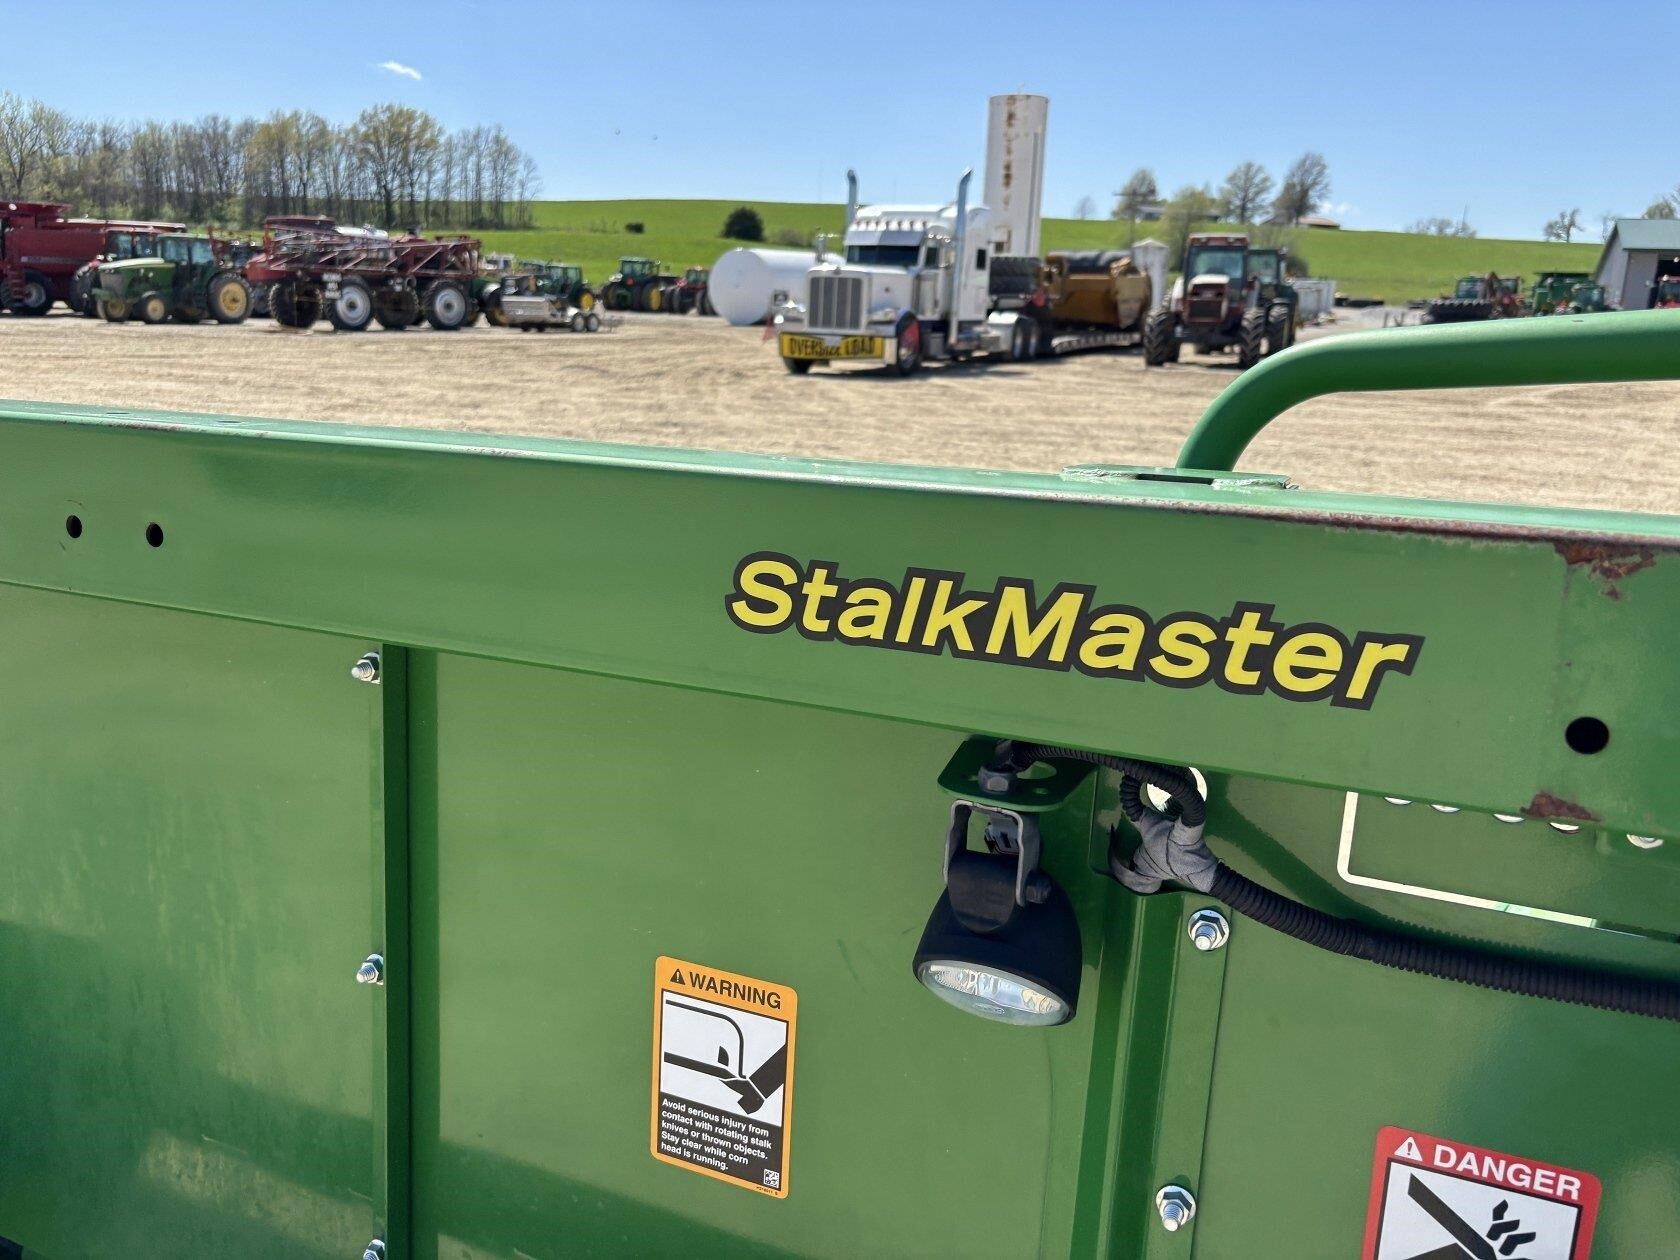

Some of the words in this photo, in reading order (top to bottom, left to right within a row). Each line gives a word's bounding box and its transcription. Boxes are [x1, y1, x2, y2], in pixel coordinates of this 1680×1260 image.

[845, 336, 875, 355] LOAD
[731, 559, 1411, 700] StalkMaster
[689, 971, 781, 1010] WARNING
[661, 1098, 686, 1112] Avoid
[688, 1106, 720, 1122] serious
[721, 1115, 747, 1131] injury
[748, 1123, 769, 1137] from
[661, 1110, 693, 1126] contact
[694, 1120, 713, 1132] with
[714, 1127, 749, 1144] rotating
[750, 1136, 772, 1150] stalk
[661, 1120, 689, 1135] knives
[690, 1130, 700, 1138] or
[701, 1132, 732, 1149] thrown
[733, 1142, 768, 1160] objects.
[661, 1131, 680, 1145] Stay
[681, 1138, 703, 1150] clear
[704, 1145, 727, 1158] while
[728, 1153, 749, 1165] corn
[661, 1142, 682, 1155] head
[683, 1148, 691, 1158] is
[692, 1153, 729, 1170] running.
[1433, 1144, 1582, 1200] DANGER
